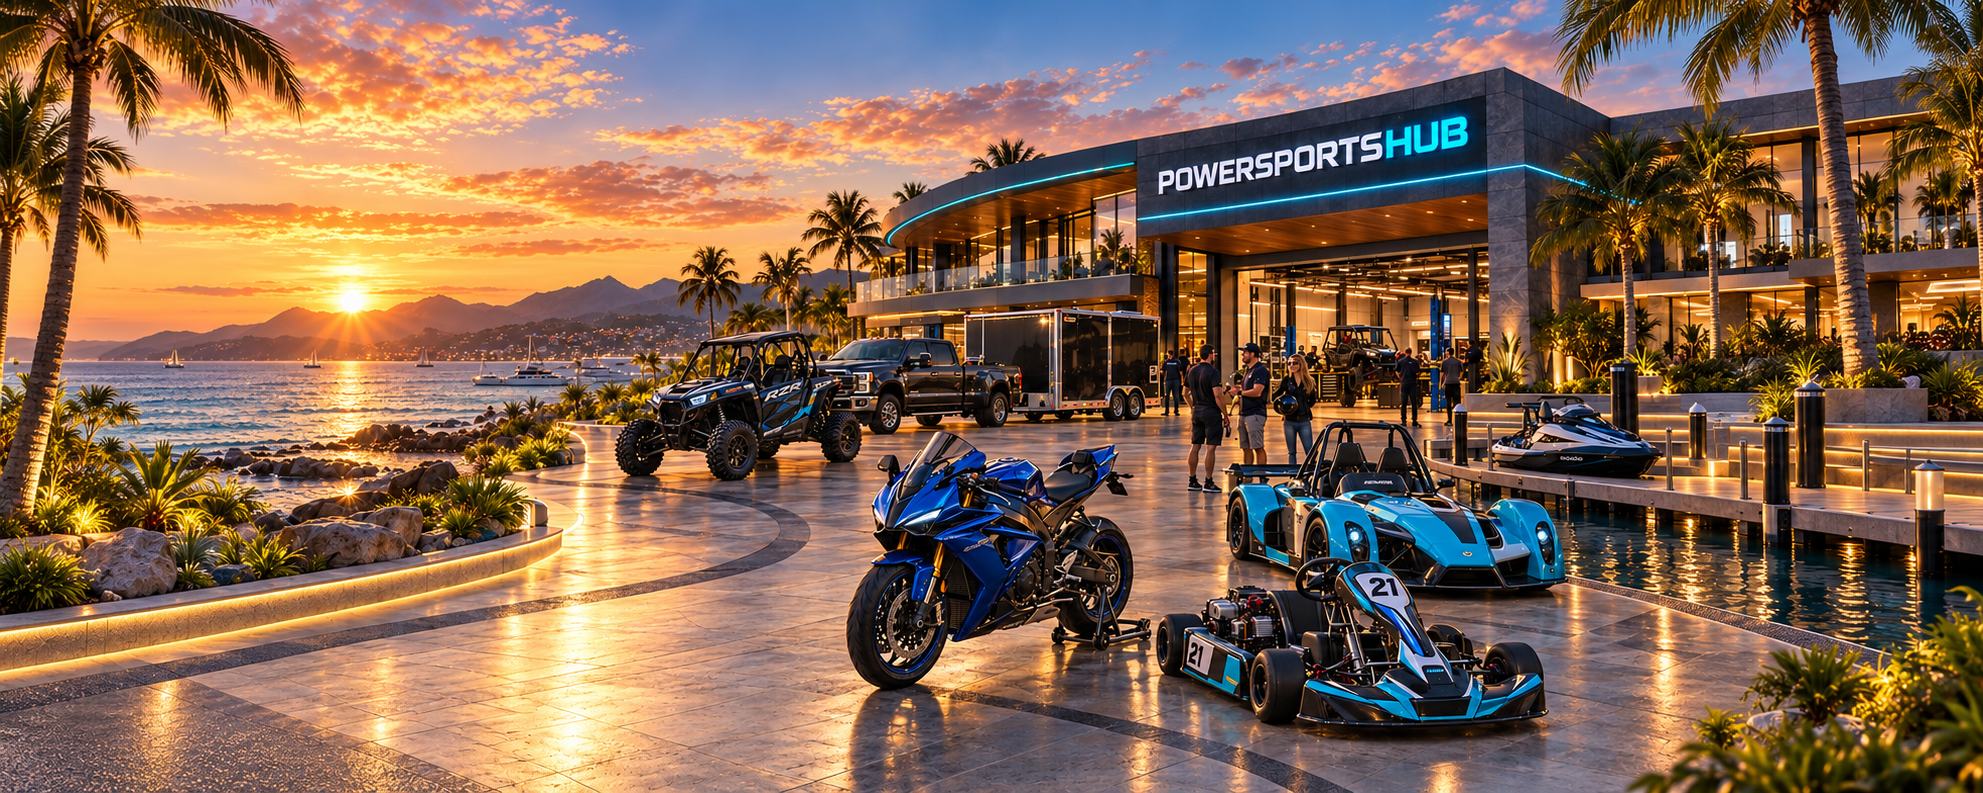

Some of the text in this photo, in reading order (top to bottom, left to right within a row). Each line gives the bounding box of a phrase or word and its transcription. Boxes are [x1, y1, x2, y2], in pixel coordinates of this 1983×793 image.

[1158, 115, 1469, 196] POWERSPORTSHUB
[764, 381, 803, 402] RZR
[1369, 577, 1399, 597] 21
[1188, 642, 1204, 668] 21
